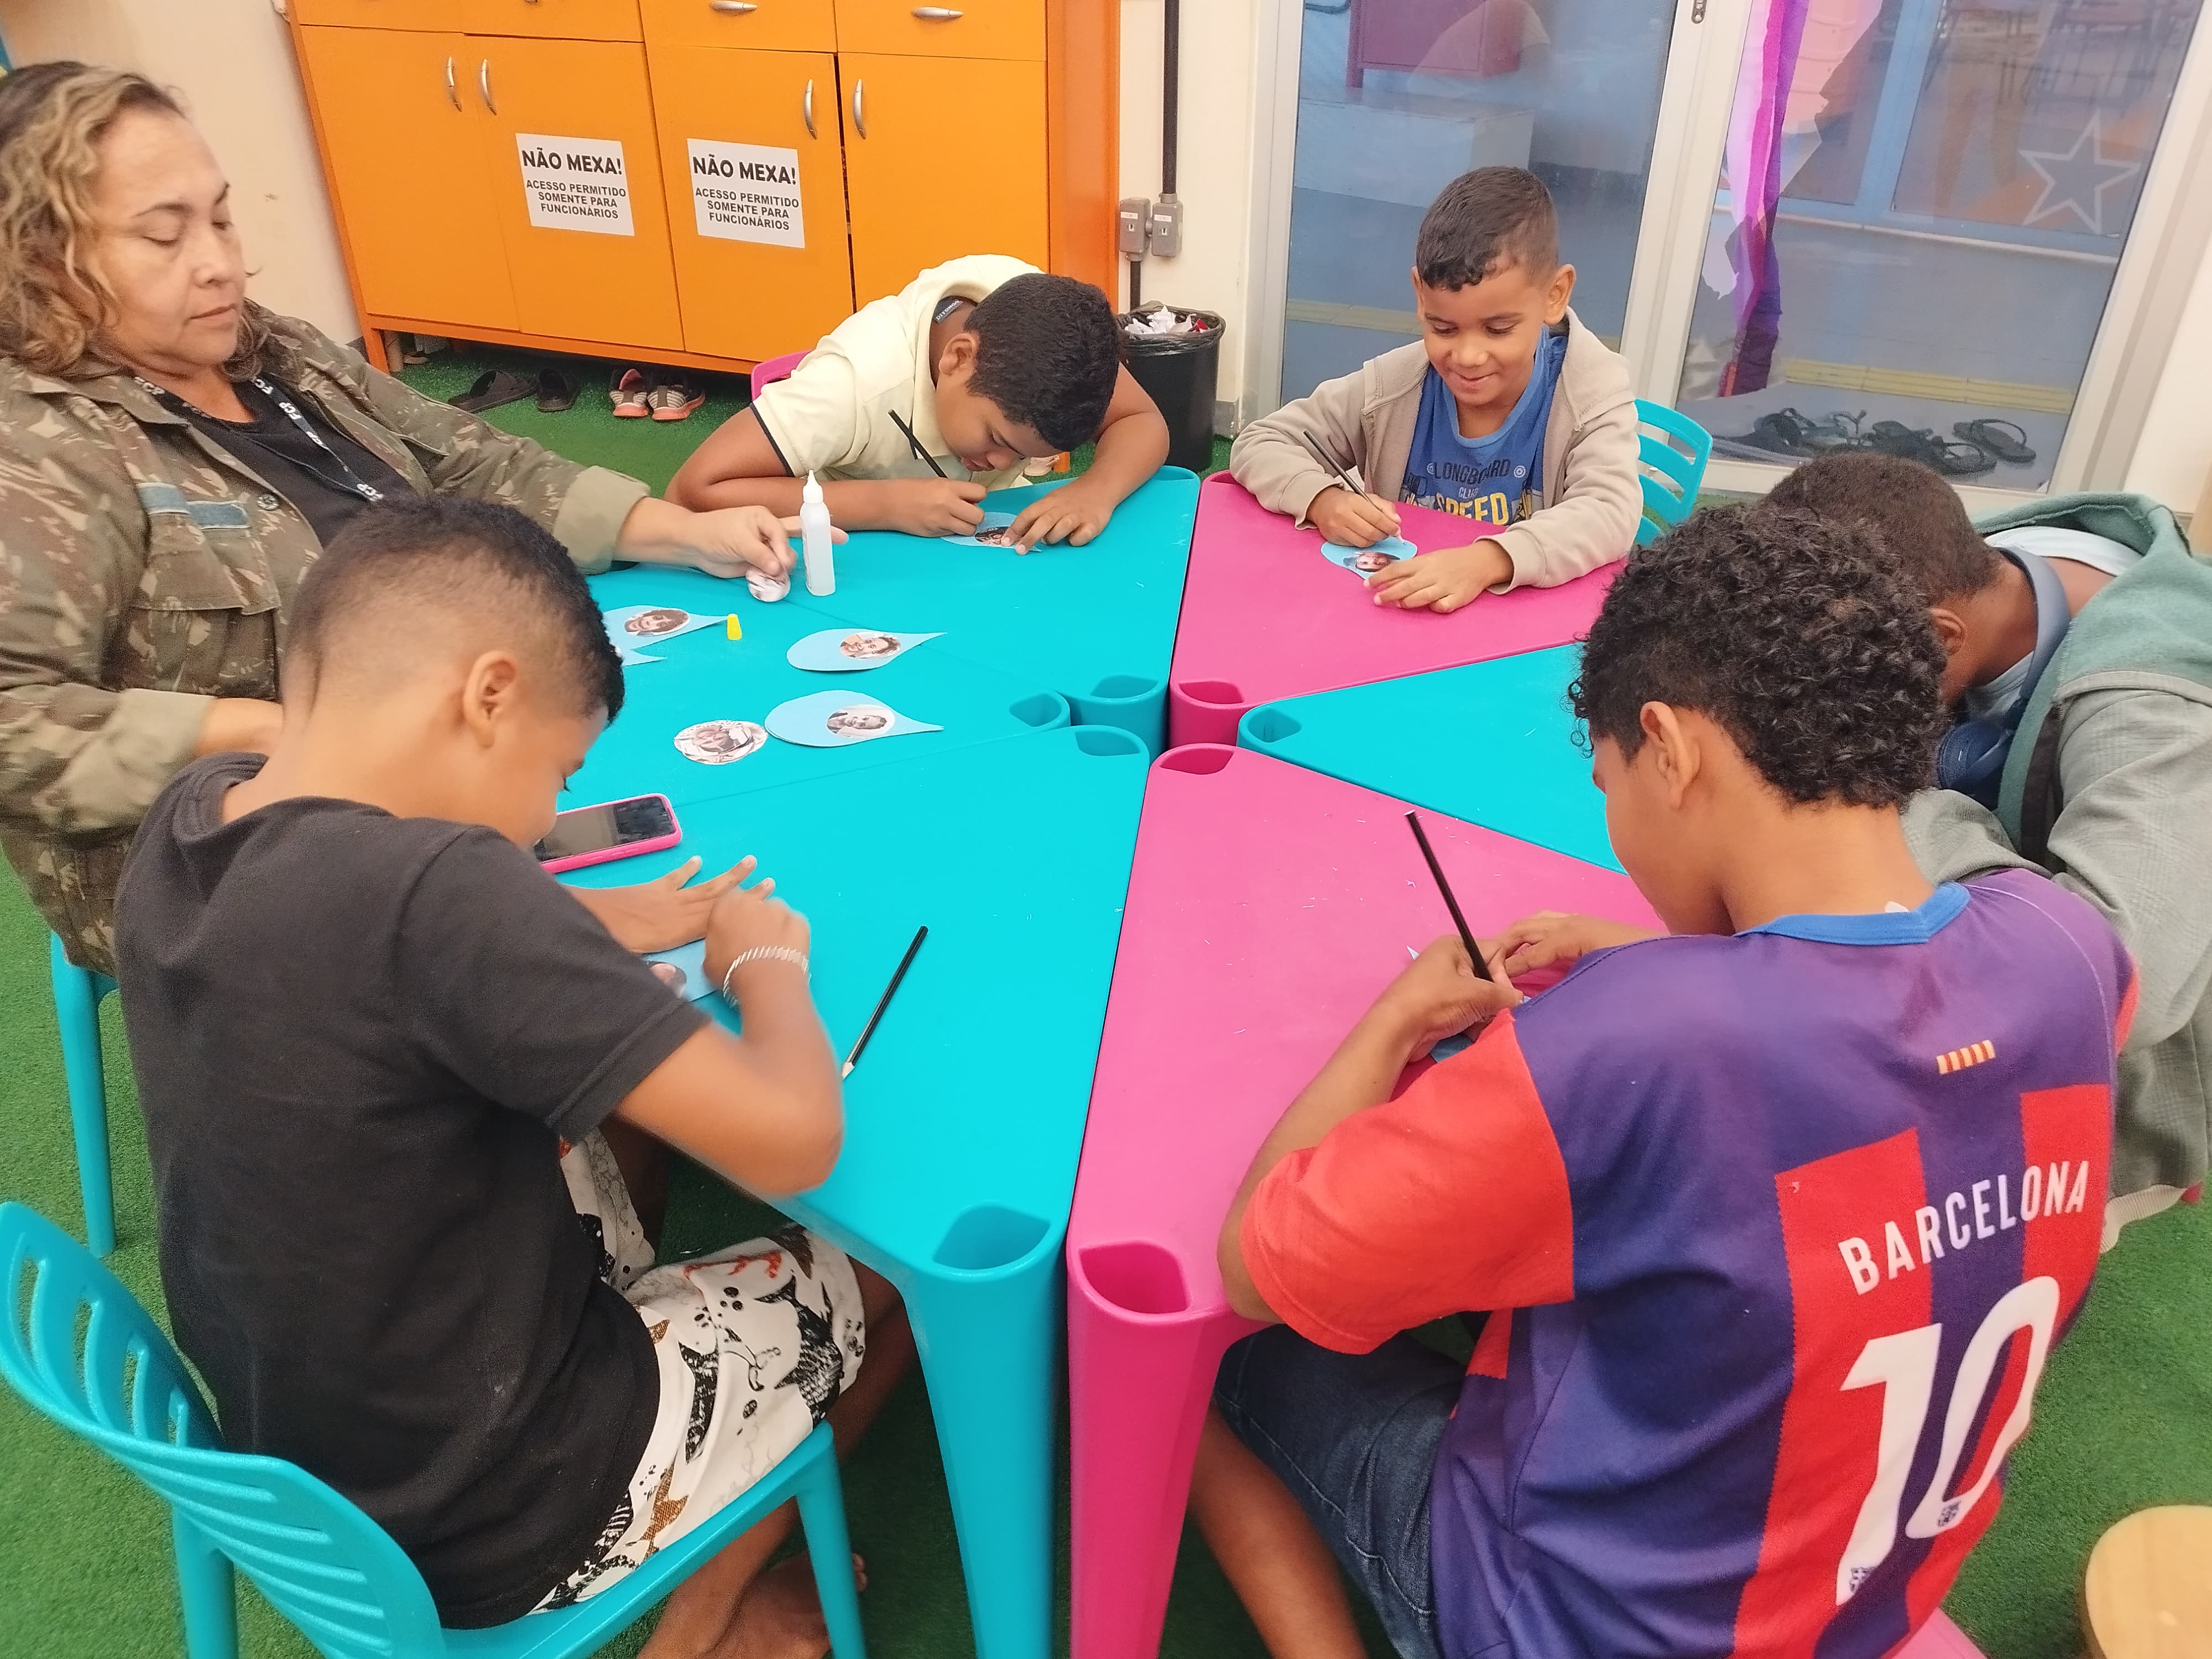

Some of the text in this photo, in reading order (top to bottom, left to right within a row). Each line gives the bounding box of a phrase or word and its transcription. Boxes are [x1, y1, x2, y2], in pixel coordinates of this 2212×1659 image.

[522, 147, 622, 175] NÃO MEXA!
[692, 154, 796, 185] NÃO MEXA!
[526, 179, 626, 197] ACESSO PERMITIDO
[538, 191, 618, 207] SOMENTE PARA
[696, 187, 799, 208] ACESSO PERMITIDO
[540, 203, 618, 218] FUNCIONÁRIOS
[707, 200, 789, 218] SOMENTE PARA
[709, 212, 790, 230] FUNCIONÁRIOS
[279, 402, 302, 420] FCP
[1838, 1160, 2089, 1296] BARCELONA
[1835, 1275, 2060, 1606] 10
